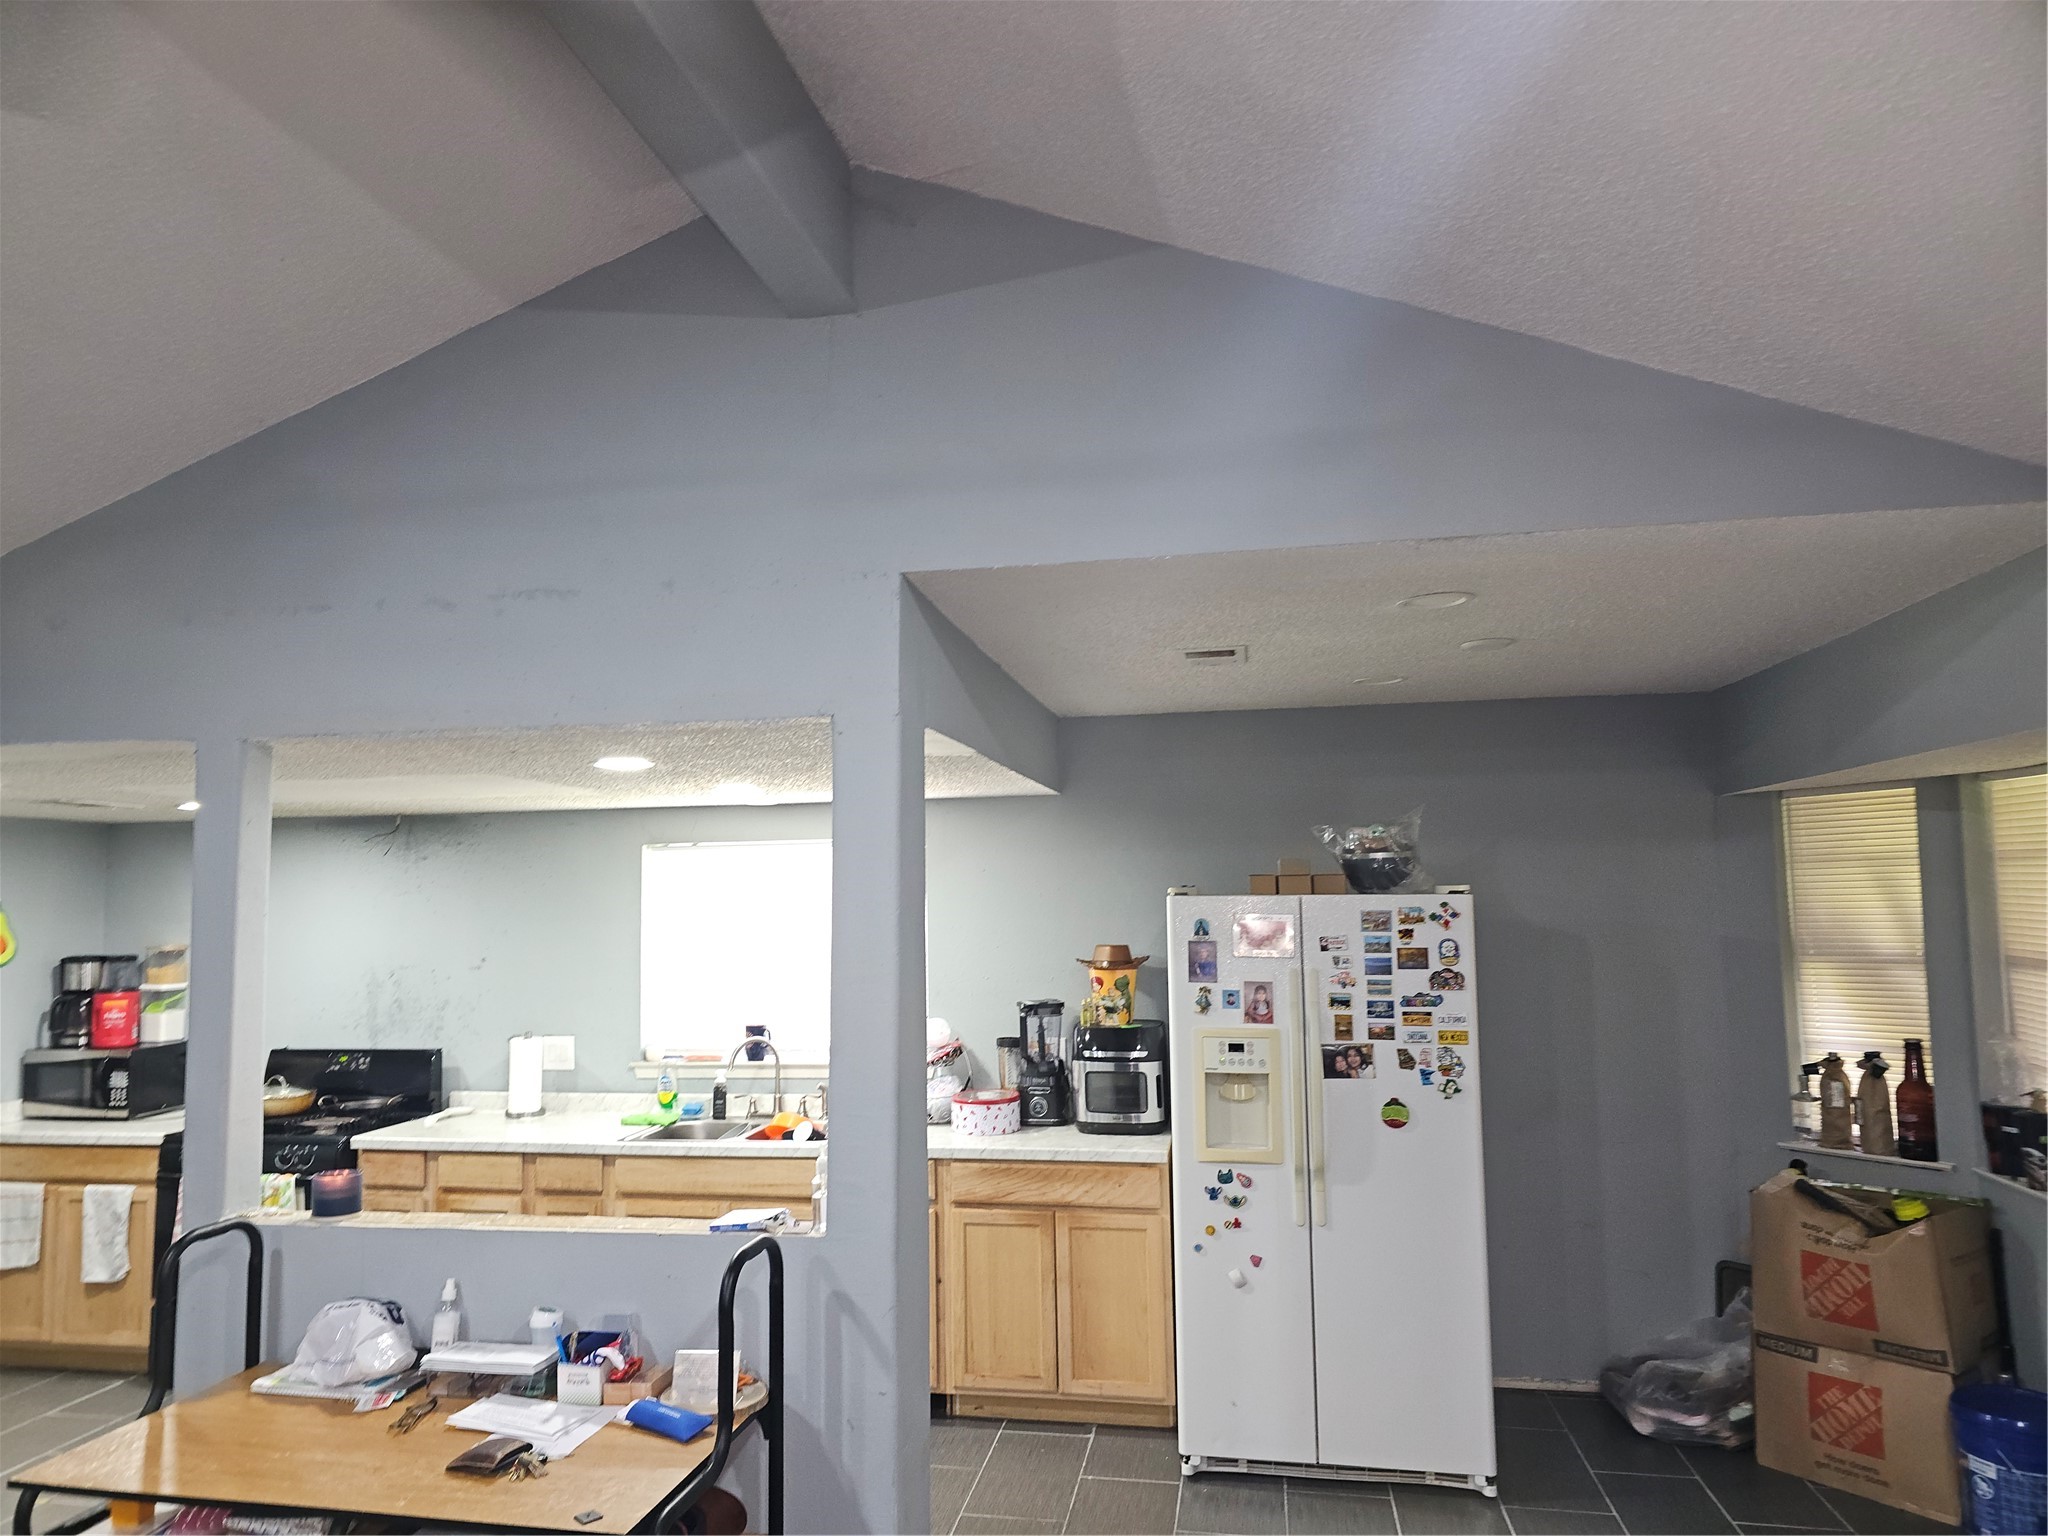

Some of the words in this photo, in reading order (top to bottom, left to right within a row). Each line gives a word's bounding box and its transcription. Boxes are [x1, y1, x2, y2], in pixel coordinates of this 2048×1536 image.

[1803, 1257, 1842, 1290] DEPOT
[1806, 1261, 1871, 1319] HOME
[1837, 1295, 1869, 1319] THE
[1759, 1335, 1813, 1361] MEDIUM
[1810, 1385, 1881, 1443] HOME
[1815, 1385, 1847, 1410] THE
[1838, 1415, 1883, 1450] DEPOT
